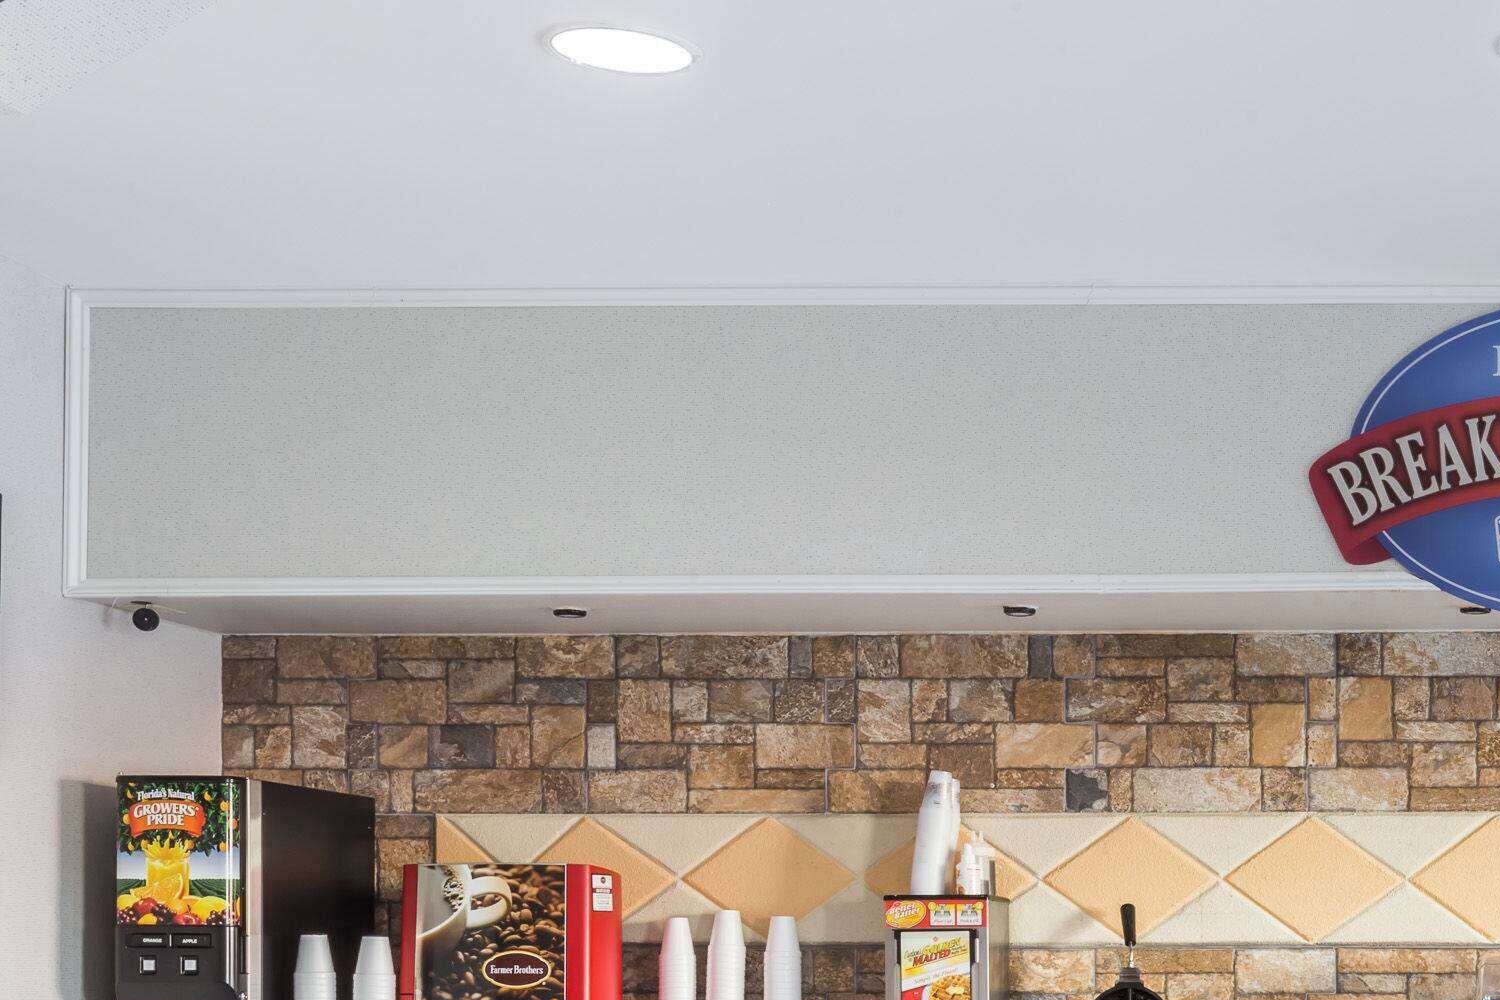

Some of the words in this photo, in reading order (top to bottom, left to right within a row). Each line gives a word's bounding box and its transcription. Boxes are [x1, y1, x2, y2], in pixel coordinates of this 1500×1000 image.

[136, 787, 167, 800] Florida's
[168, 788, 195, 800] Natural
[147, 814, 185, 826] PRIDE
[490, 964, 513, 974] Farmer
[513, 964, 544, 975] Brothers
